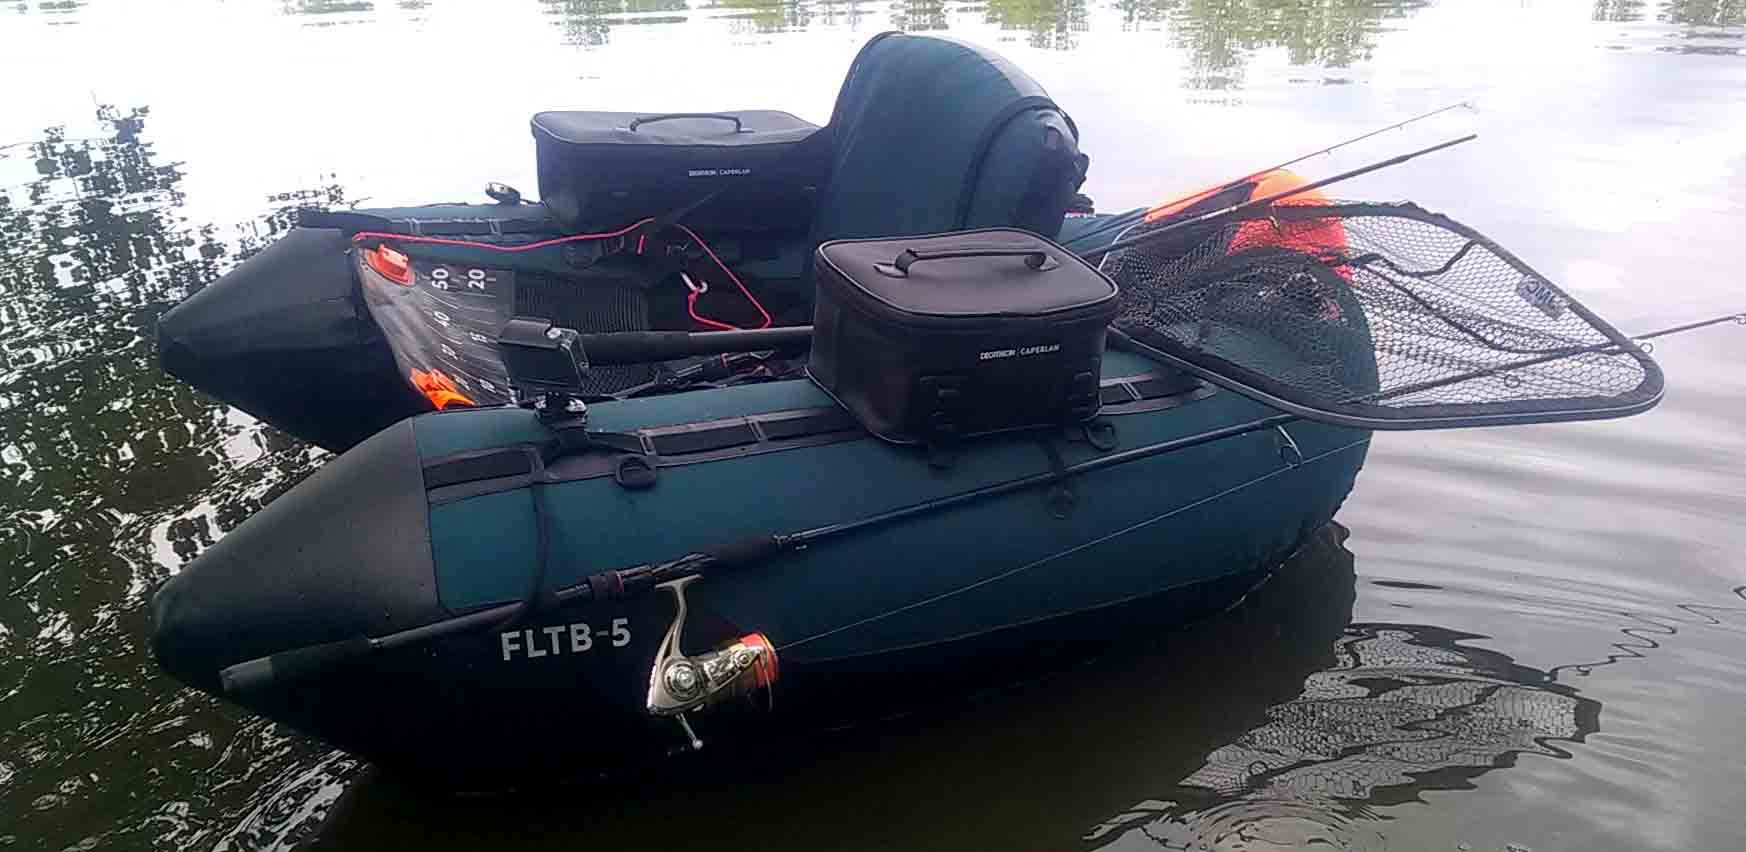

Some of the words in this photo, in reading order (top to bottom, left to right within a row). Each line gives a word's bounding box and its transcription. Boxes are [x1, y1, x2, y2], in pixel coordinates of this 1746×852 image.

[431, 268, 449, 290] 50
[467, 268, 485, 290] 20
[501, 617, 631, 661] FLTB-5
